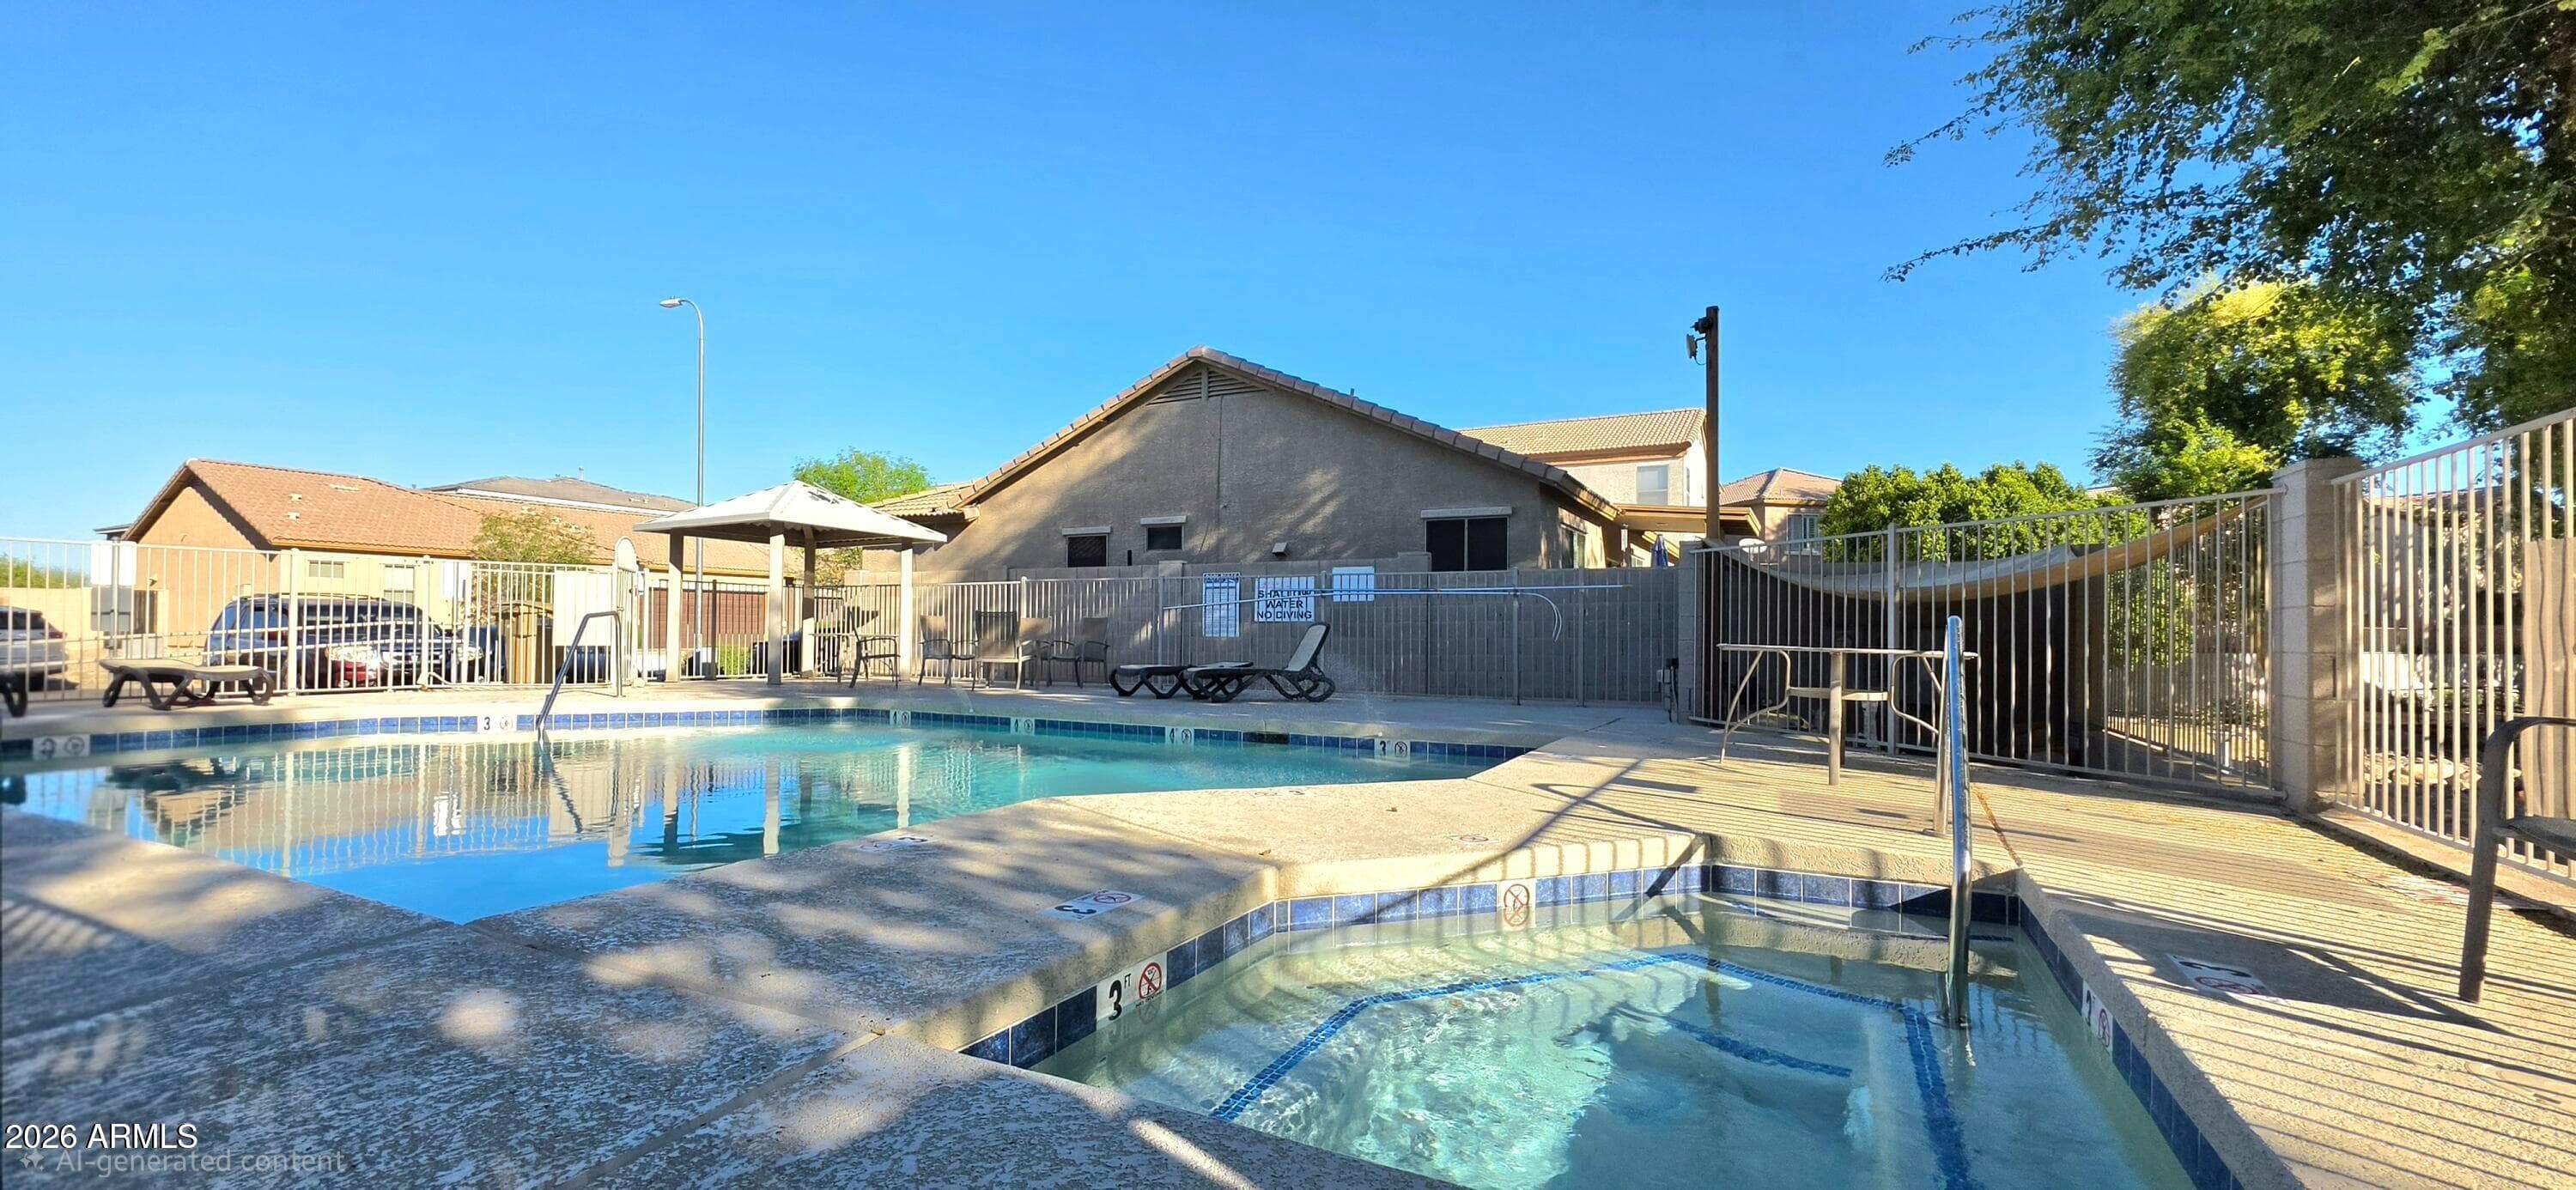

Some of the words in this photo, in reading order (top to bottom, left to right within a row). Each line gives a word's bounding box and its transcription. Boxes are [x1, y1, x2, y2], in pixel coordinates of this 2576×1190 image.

[1266, 600, 1303, 609] WATER
[1257, 610, 1273, 619] NO
[1276, 610, 1312, 619] DIVING
[483, 716, 490, 730] 3
[1109, 980, 1122, 1021] 3
